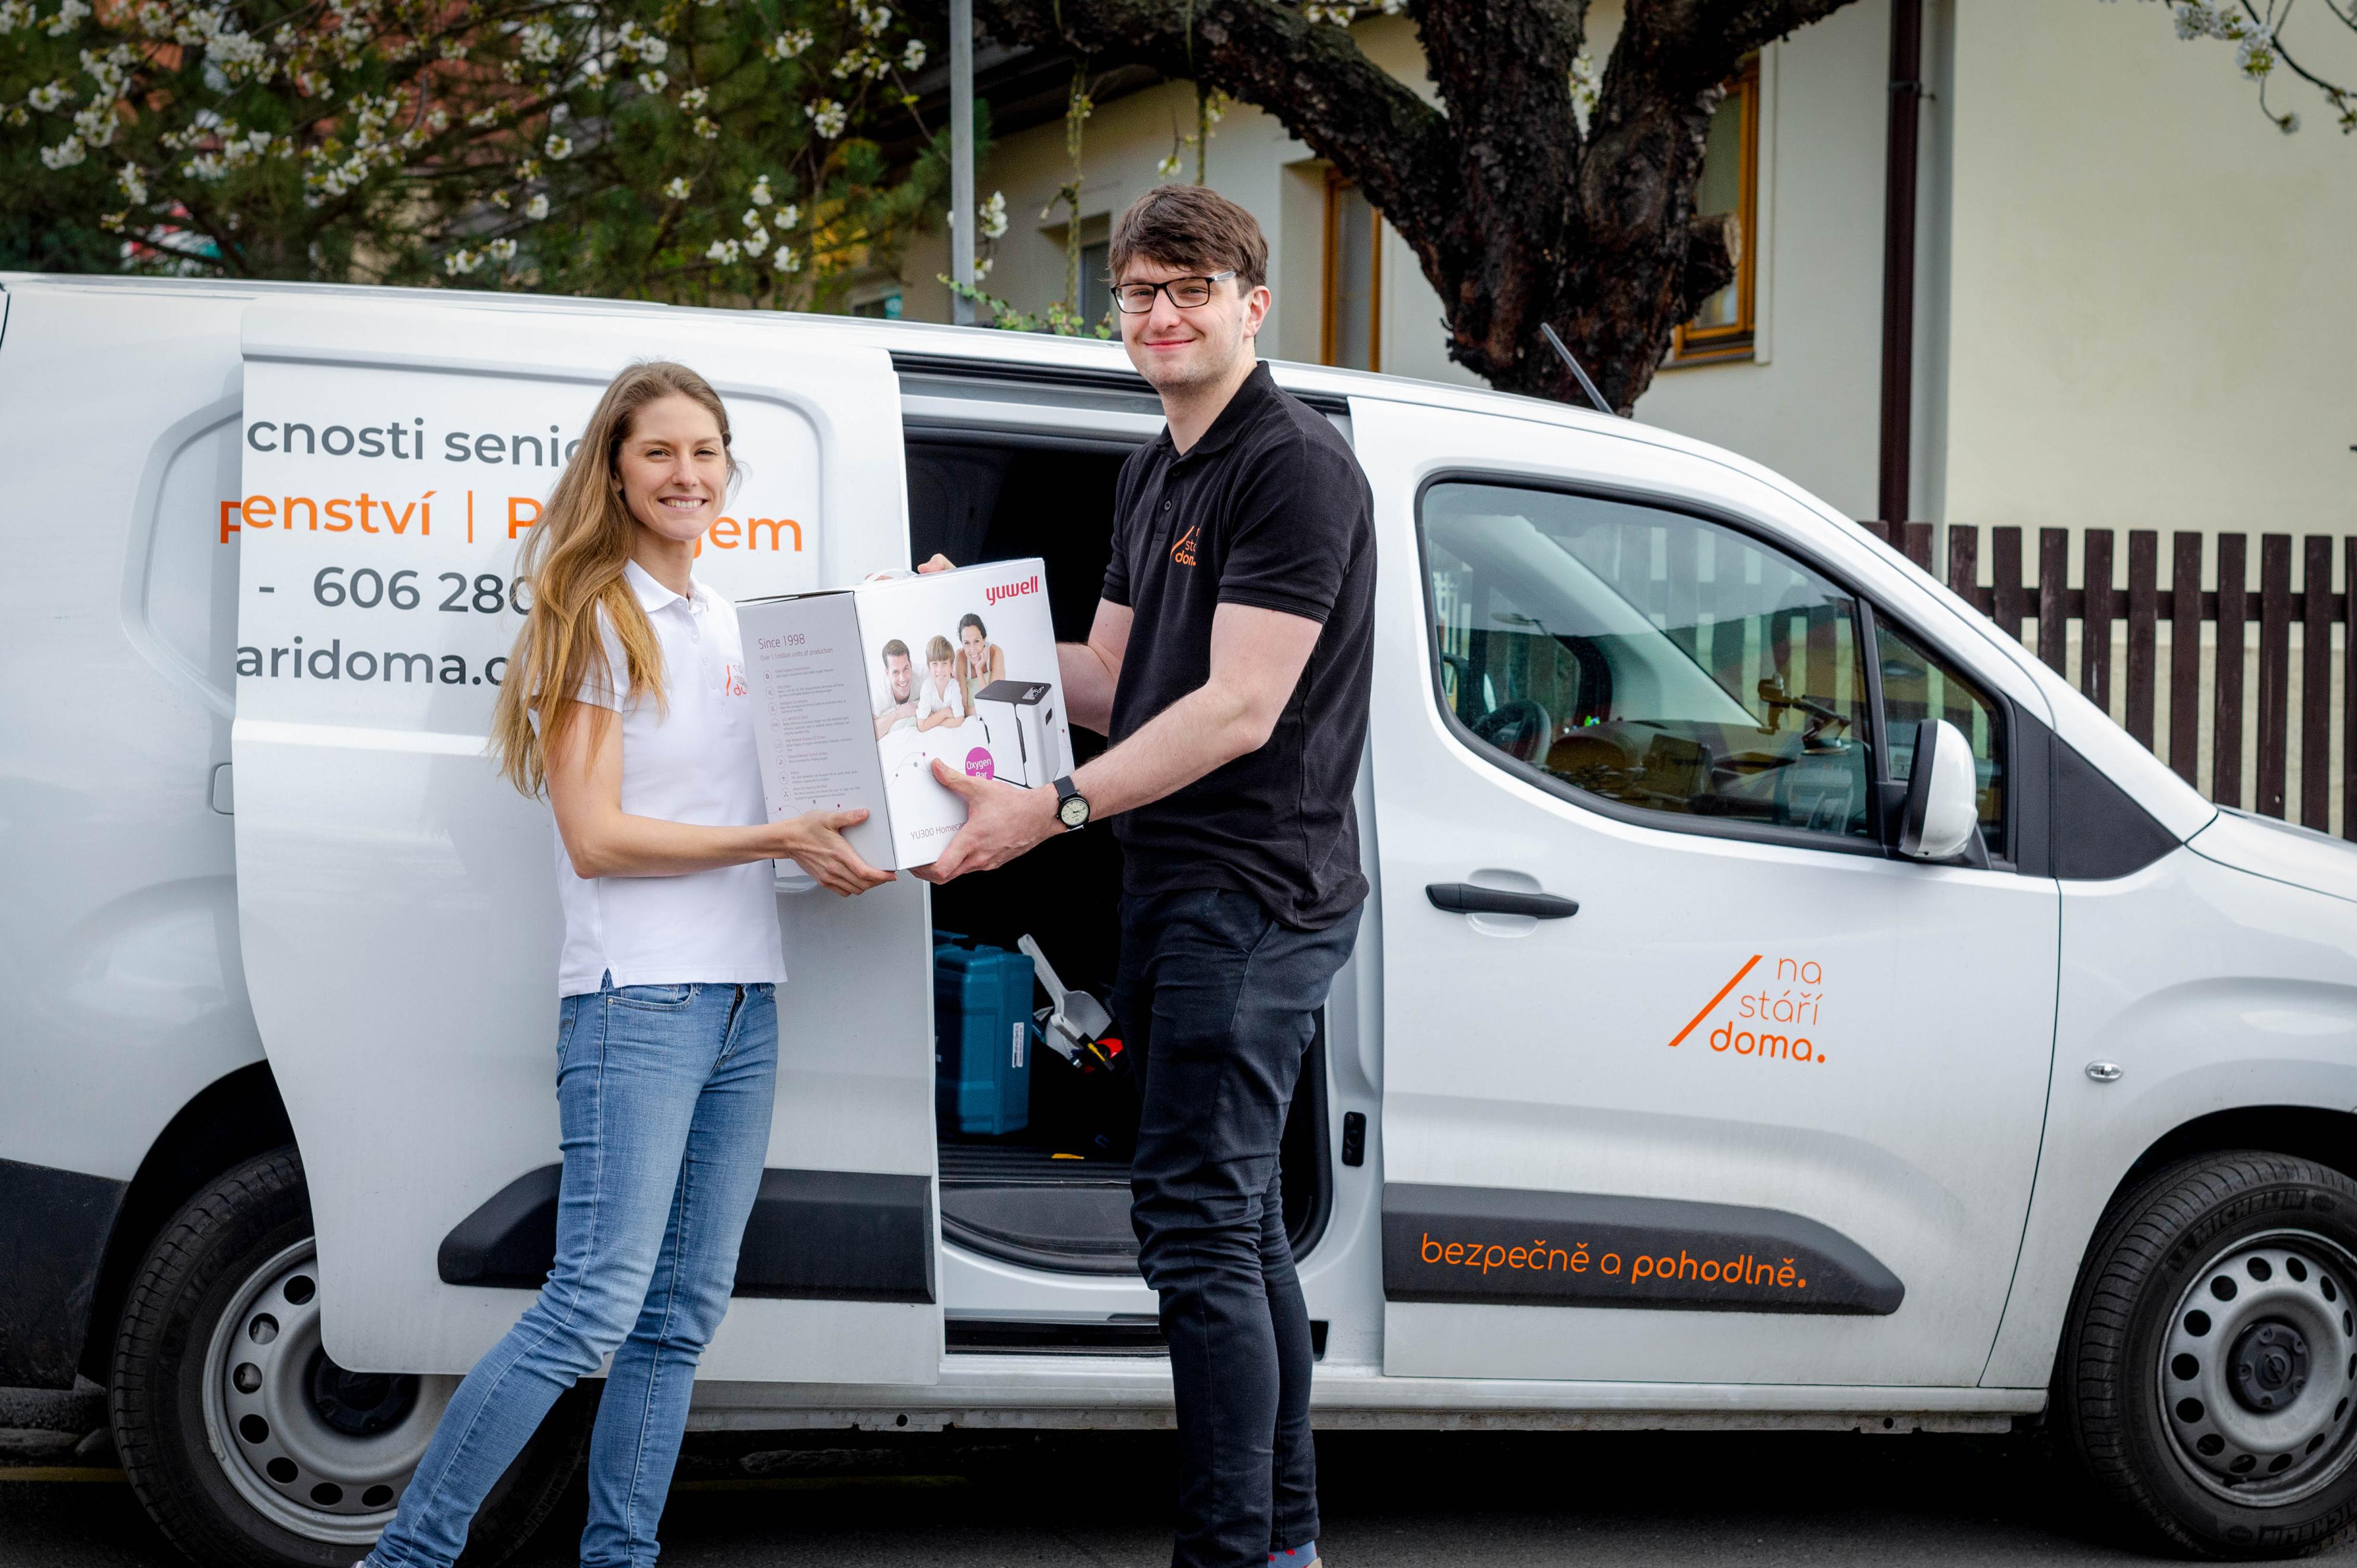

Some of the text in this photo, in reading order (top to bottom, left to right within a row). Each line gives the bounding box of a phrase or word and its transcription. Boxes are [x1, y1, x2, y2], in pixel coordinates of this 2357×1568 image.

[247, 418, 424, 460] cnosti
[313, 567, 420, 611] 606
[986, 575, 1038, 606] yuwell
[236, 635, 509, 686] aridoma.c
[758, 634, 805, 649] Since 1998
[809, 648, 834, 656] production
[966, 759, 991, 770] Oxygen
[911, 822, 966, 840] YU300 Homecar
[1777, 958, 1821, 985] na
[1739, 990, 1823, 1026] stáří
[1710, 1020, 1825, 1063] doma.
[2193, 1190, 2308, 1245] MICHELIN
[1421, 1233, 1806, 1288] bezpečně a pohodlně.
[2259, 1495, 2357, 1548] ICHELIN
